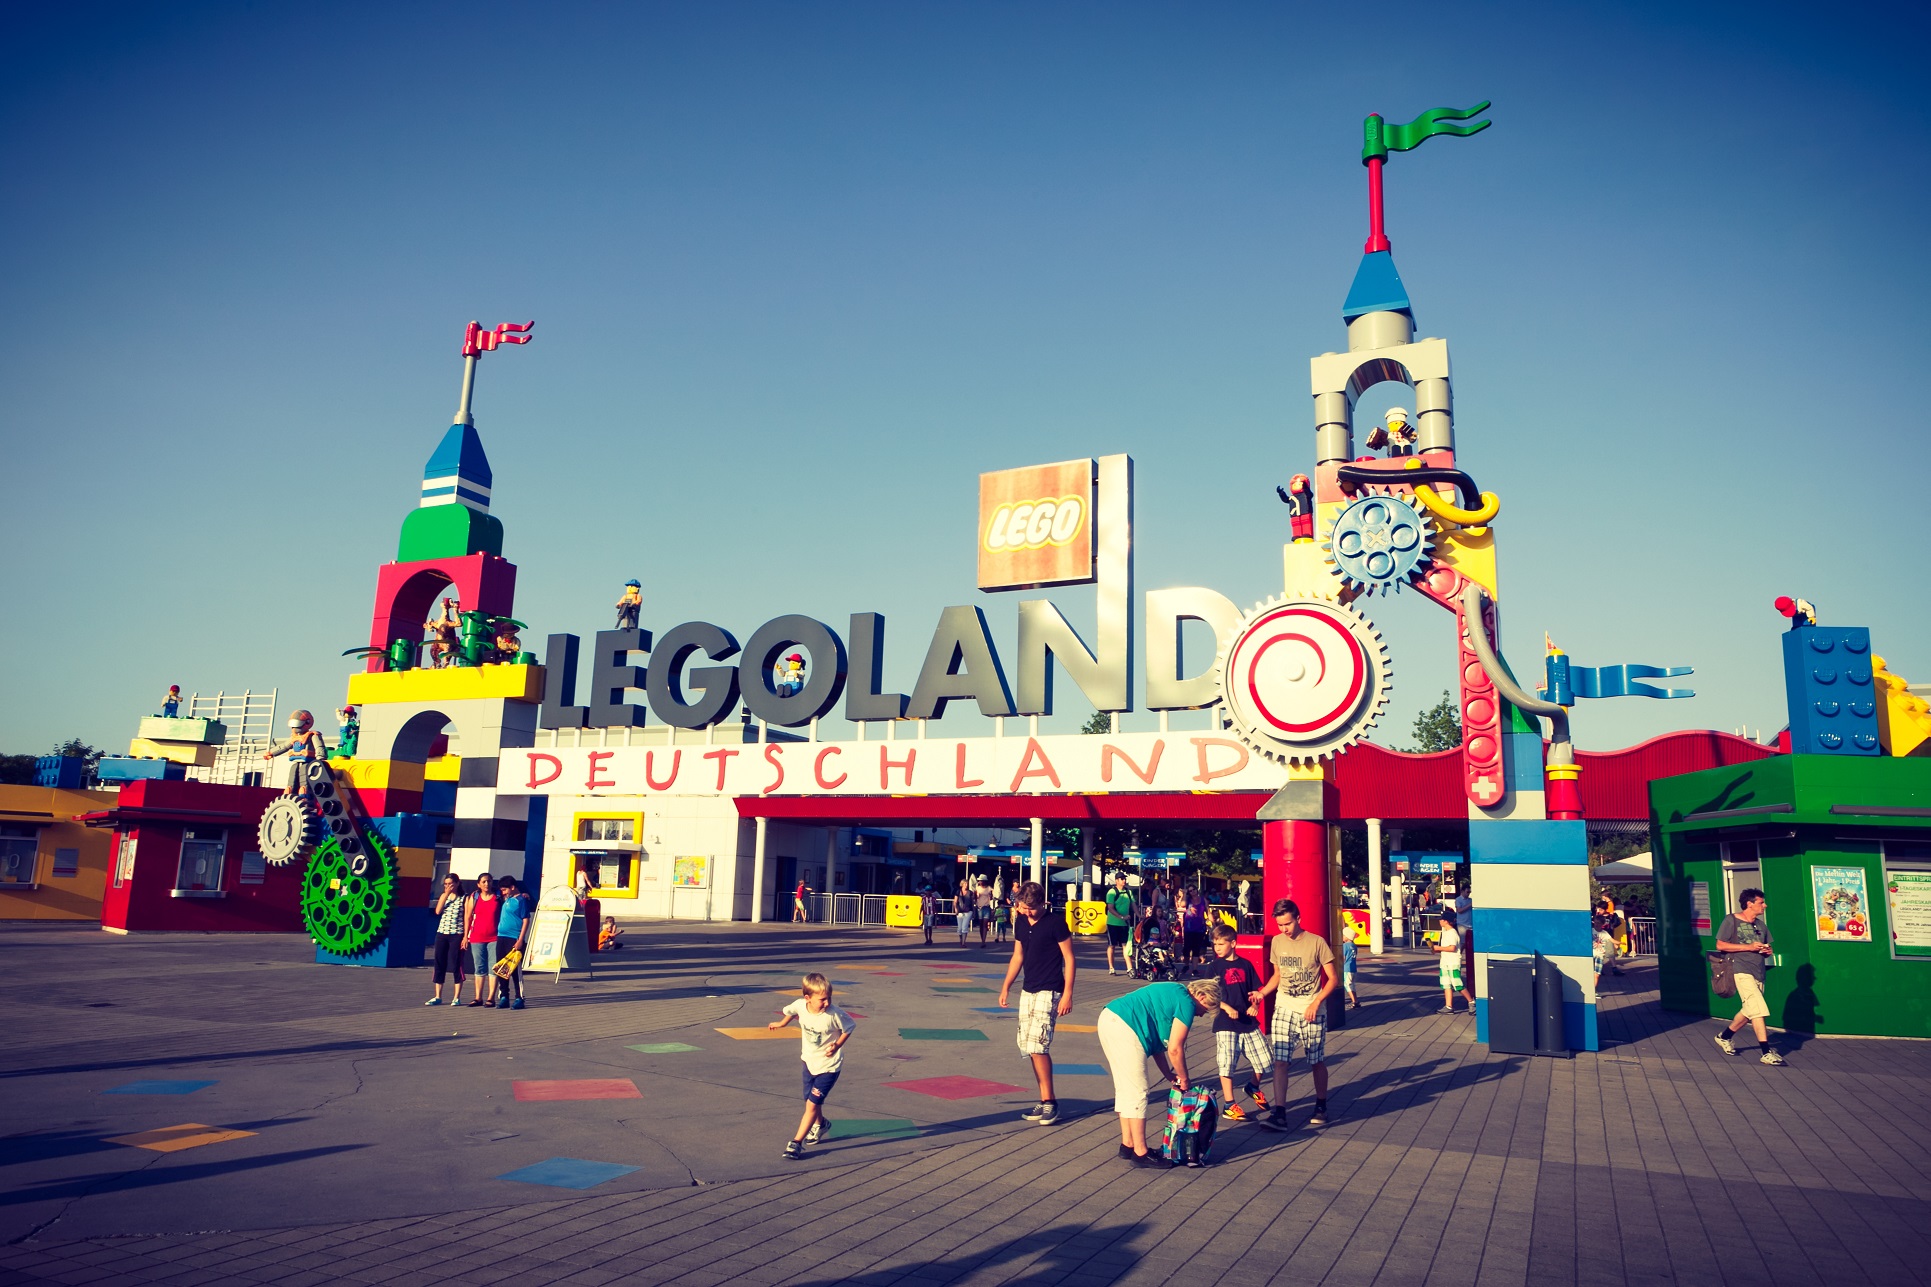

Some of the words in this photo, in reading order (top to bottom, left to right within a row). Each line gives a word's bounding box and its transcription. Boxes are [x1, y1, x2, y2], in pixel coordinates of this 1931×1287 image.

[988, 499, 1081, 548] LEGO
[539, 587, 1244, 730] LEGOLAND
[526, 736, 1250, 794] DEUTSCHLAND
[1280, 956, 1303, 967] URBAN
[1294, 971, 1313, 982] CODE
